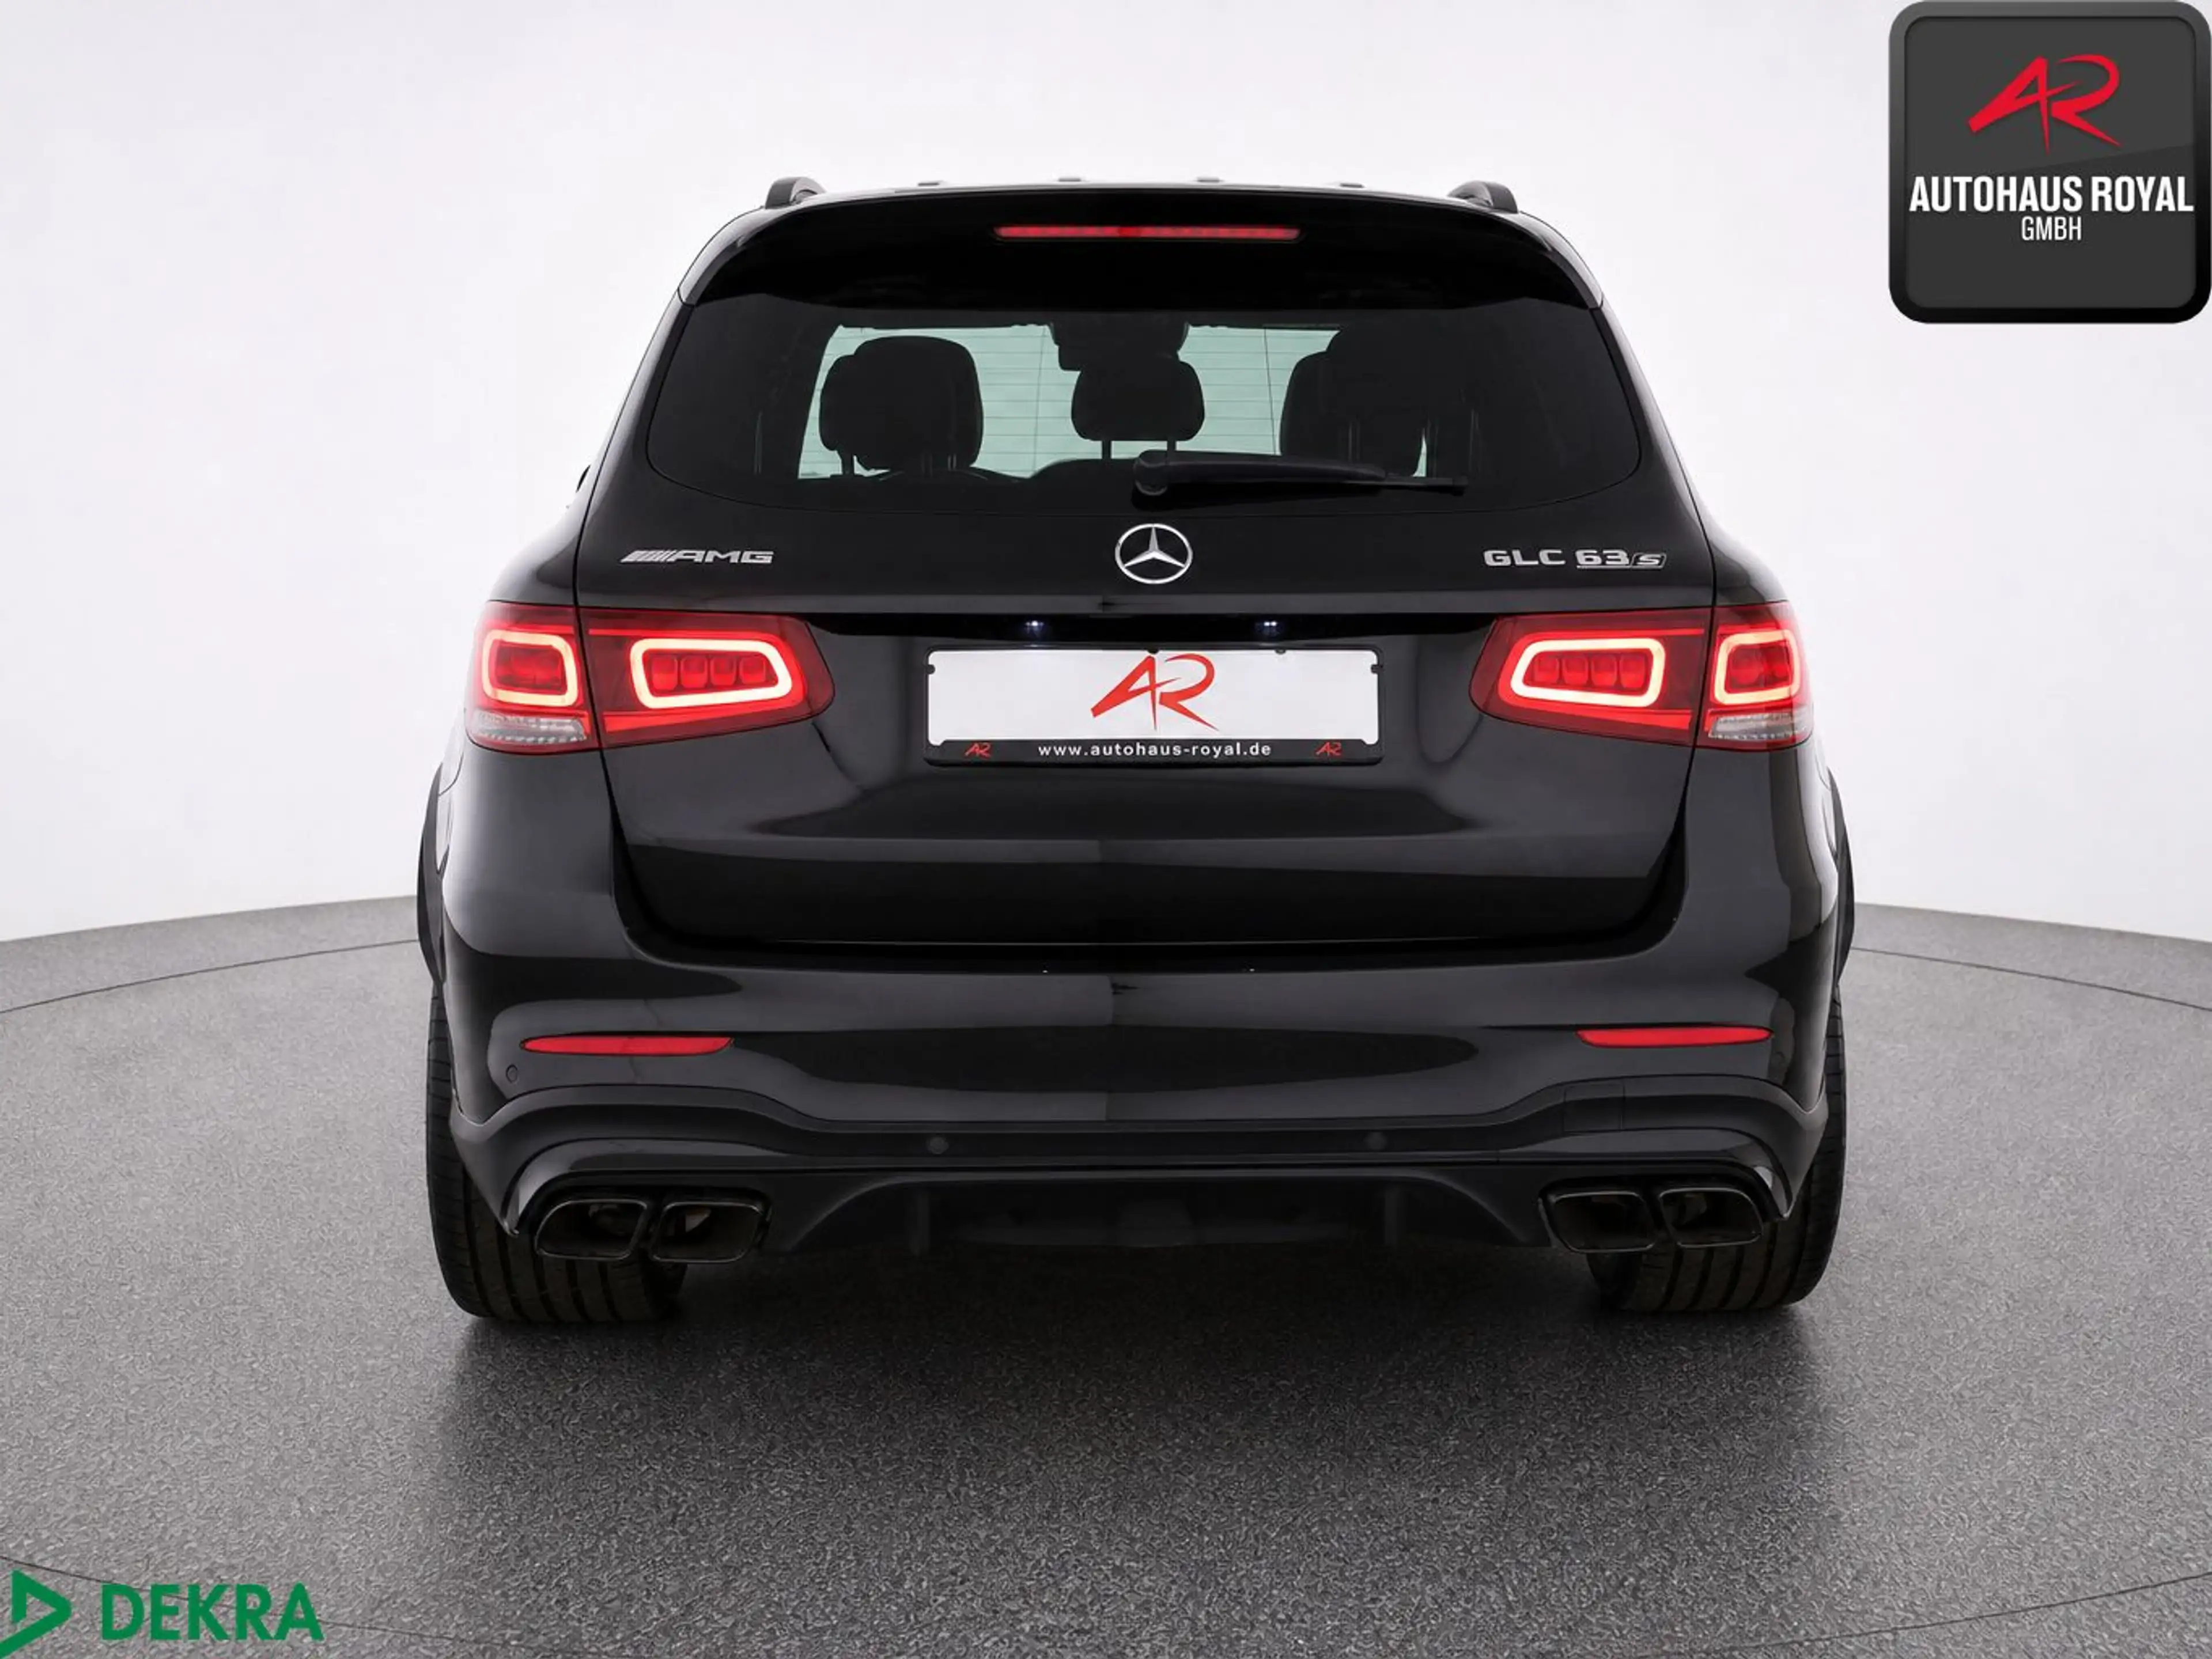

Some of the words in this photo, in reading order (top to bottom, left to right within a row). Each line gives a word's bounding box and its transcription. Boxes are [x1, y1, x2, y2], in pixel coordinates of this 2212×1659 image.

[666, 550, 774, 564] AMG
[1483, 549, 1567, 567] GLC
[1038, 741, 1272, 759] www.autohaus-royal.de
